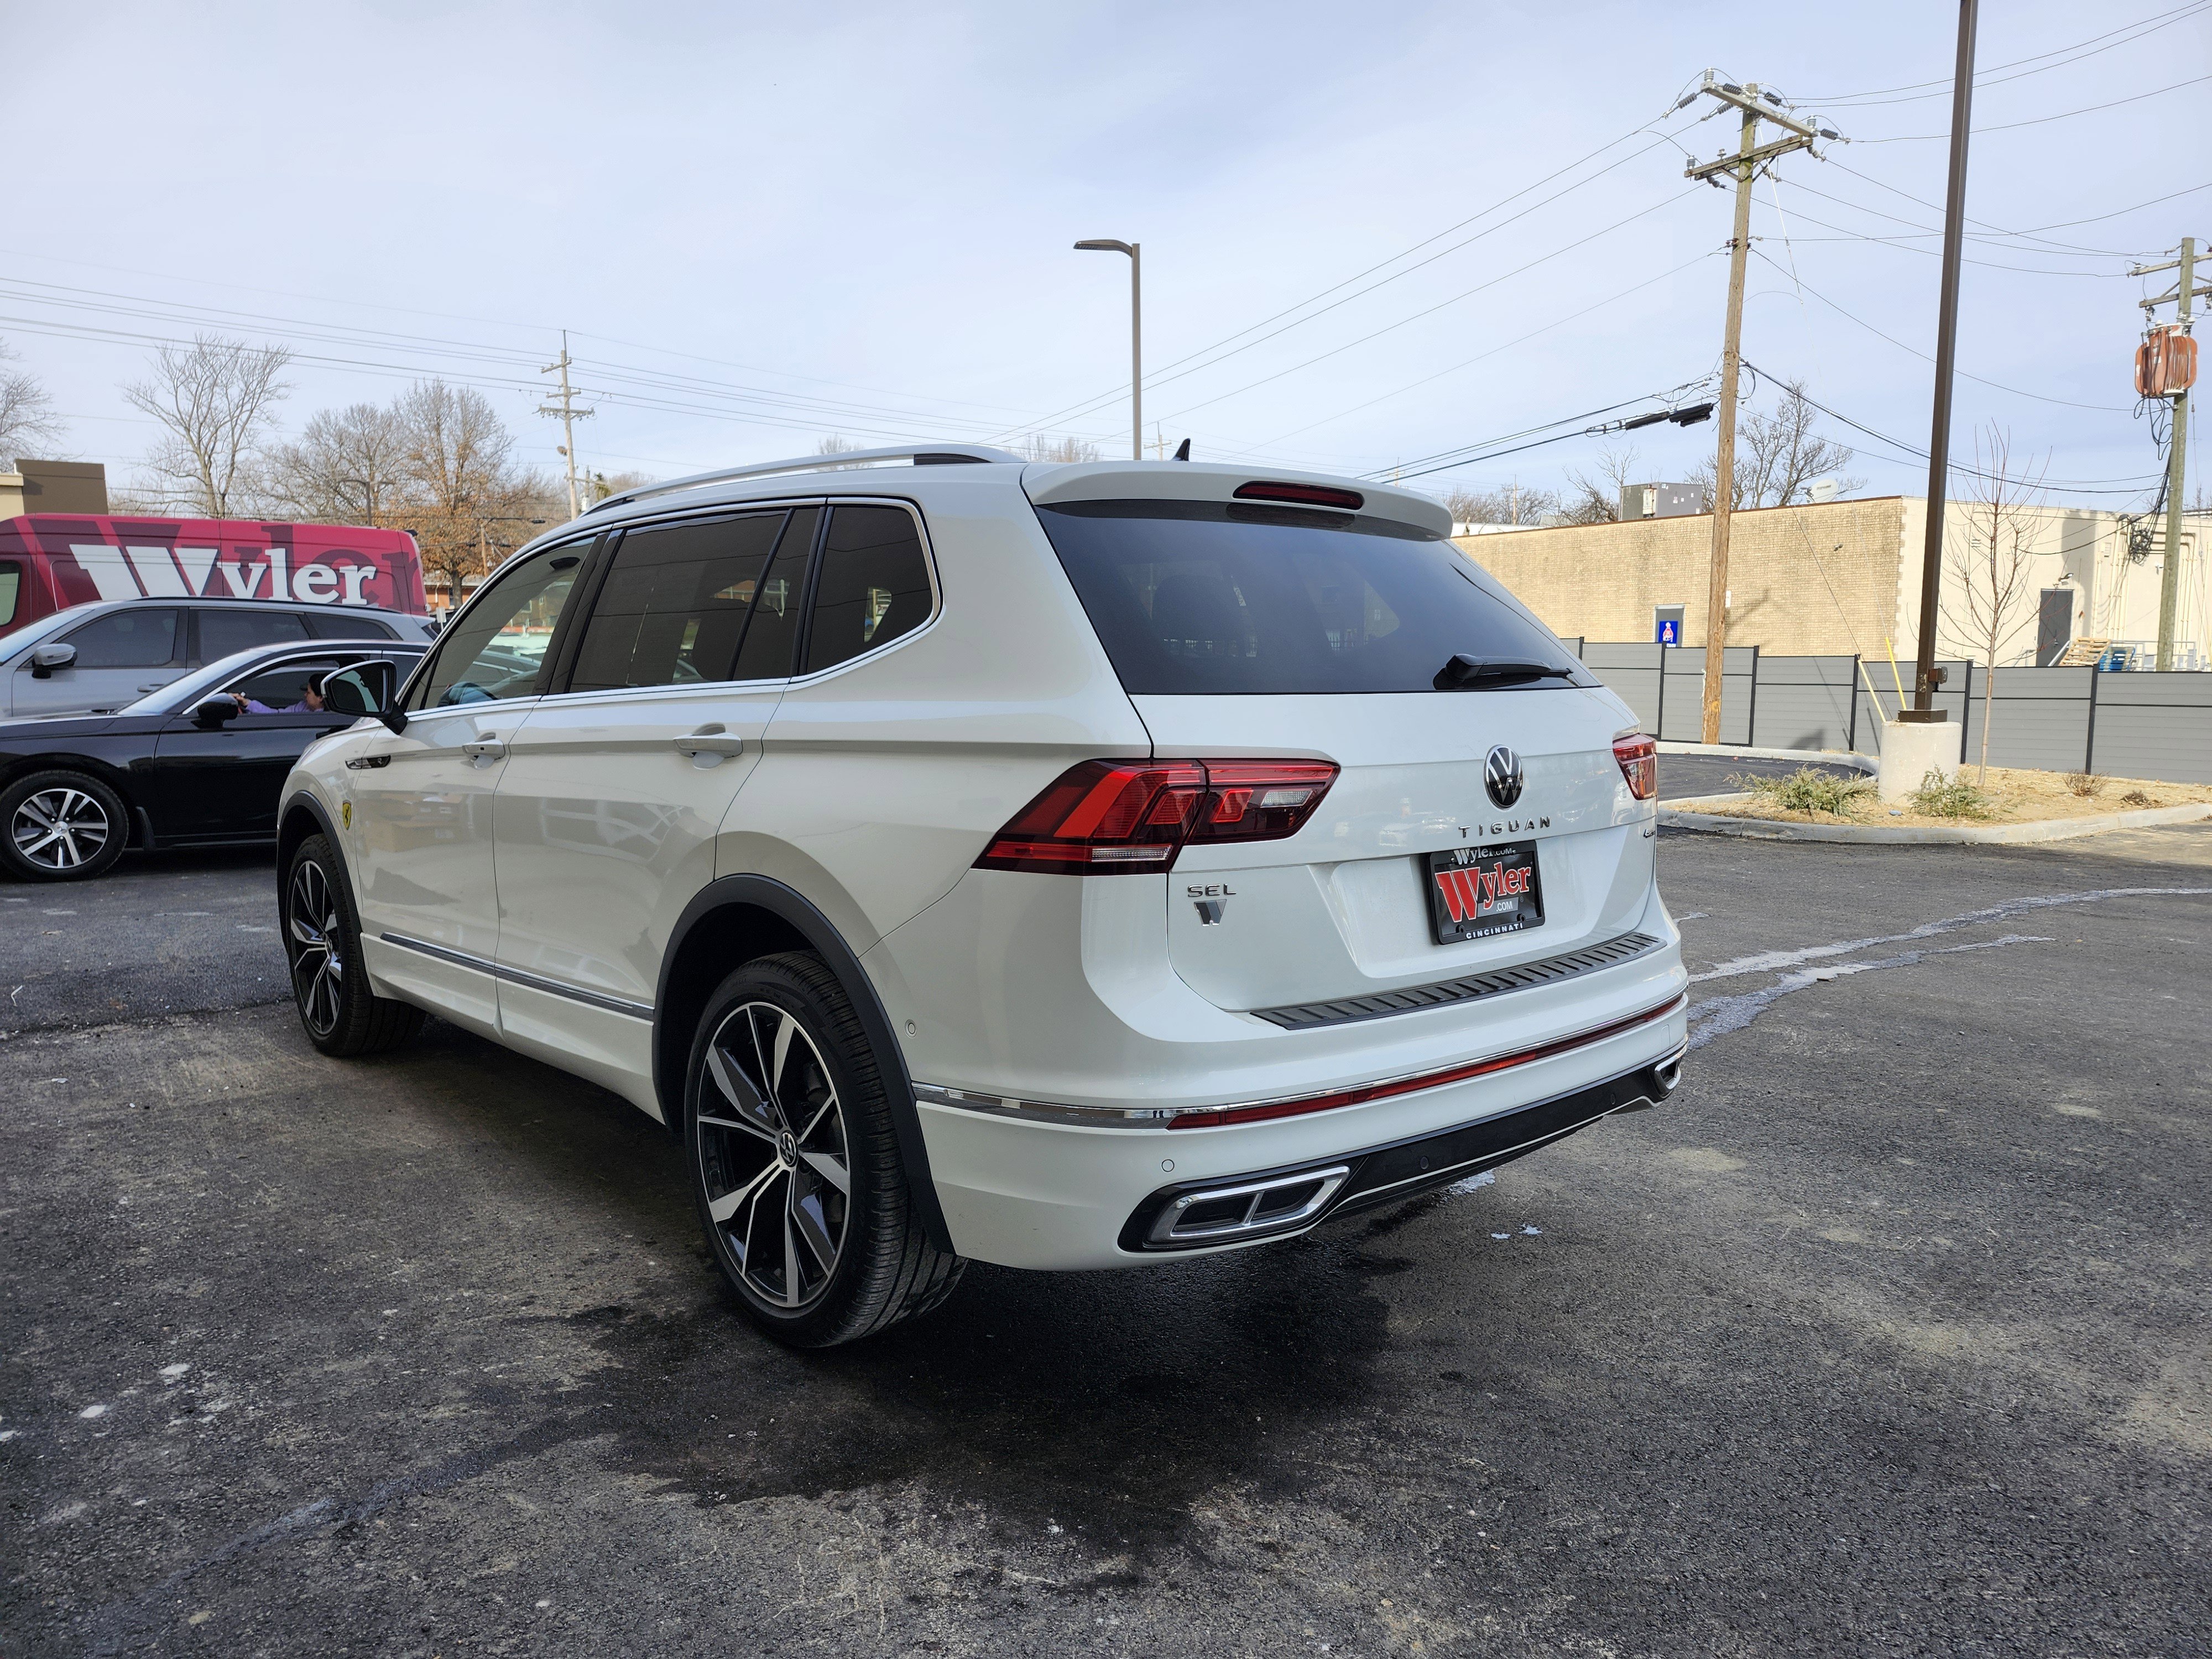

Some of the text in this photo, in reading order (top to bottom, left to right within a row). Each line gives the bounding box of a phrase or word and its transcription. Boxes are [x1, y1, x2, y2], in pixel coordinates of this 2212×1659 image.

[69, 544, 376, 605] Wyler
[1458, 816, 1551, 838] TIGUAN
[1187, 883, 1237, 898] SEL
[1434, 861, 1532, 923] Wyler
[1465, 922, 1524, 940] CINCINNATI
